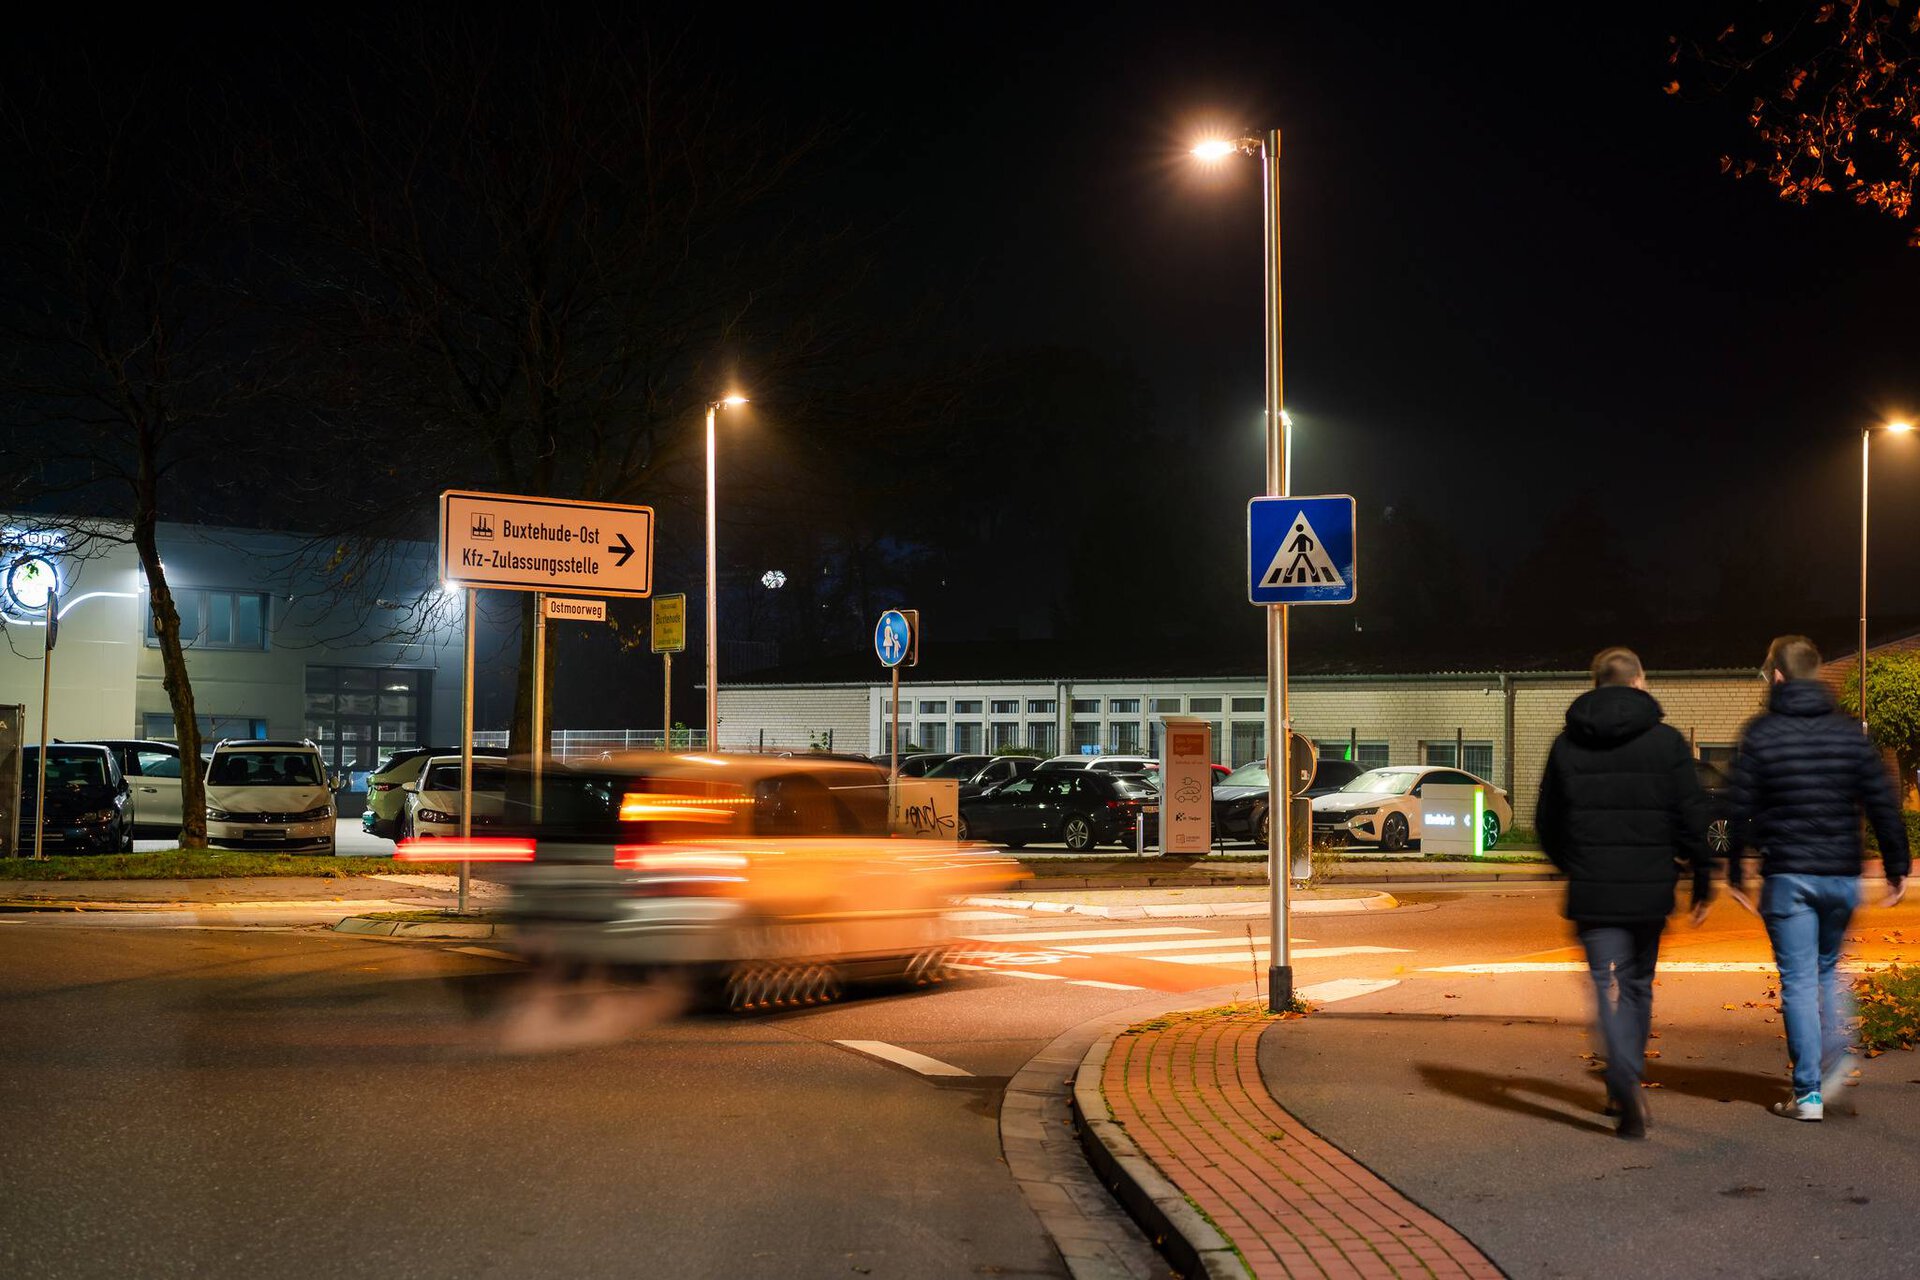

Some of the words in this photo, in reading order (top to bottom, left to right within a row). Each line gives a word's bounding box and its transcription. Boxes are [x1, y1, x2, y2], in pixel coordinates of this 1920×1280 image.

[503, 520, 600, 544] Buxtehude-Ost
[463, 548, 599, 576] Kfz-Zulassungsstelle
[551, 601, 602, 618] Ostmoorweg
